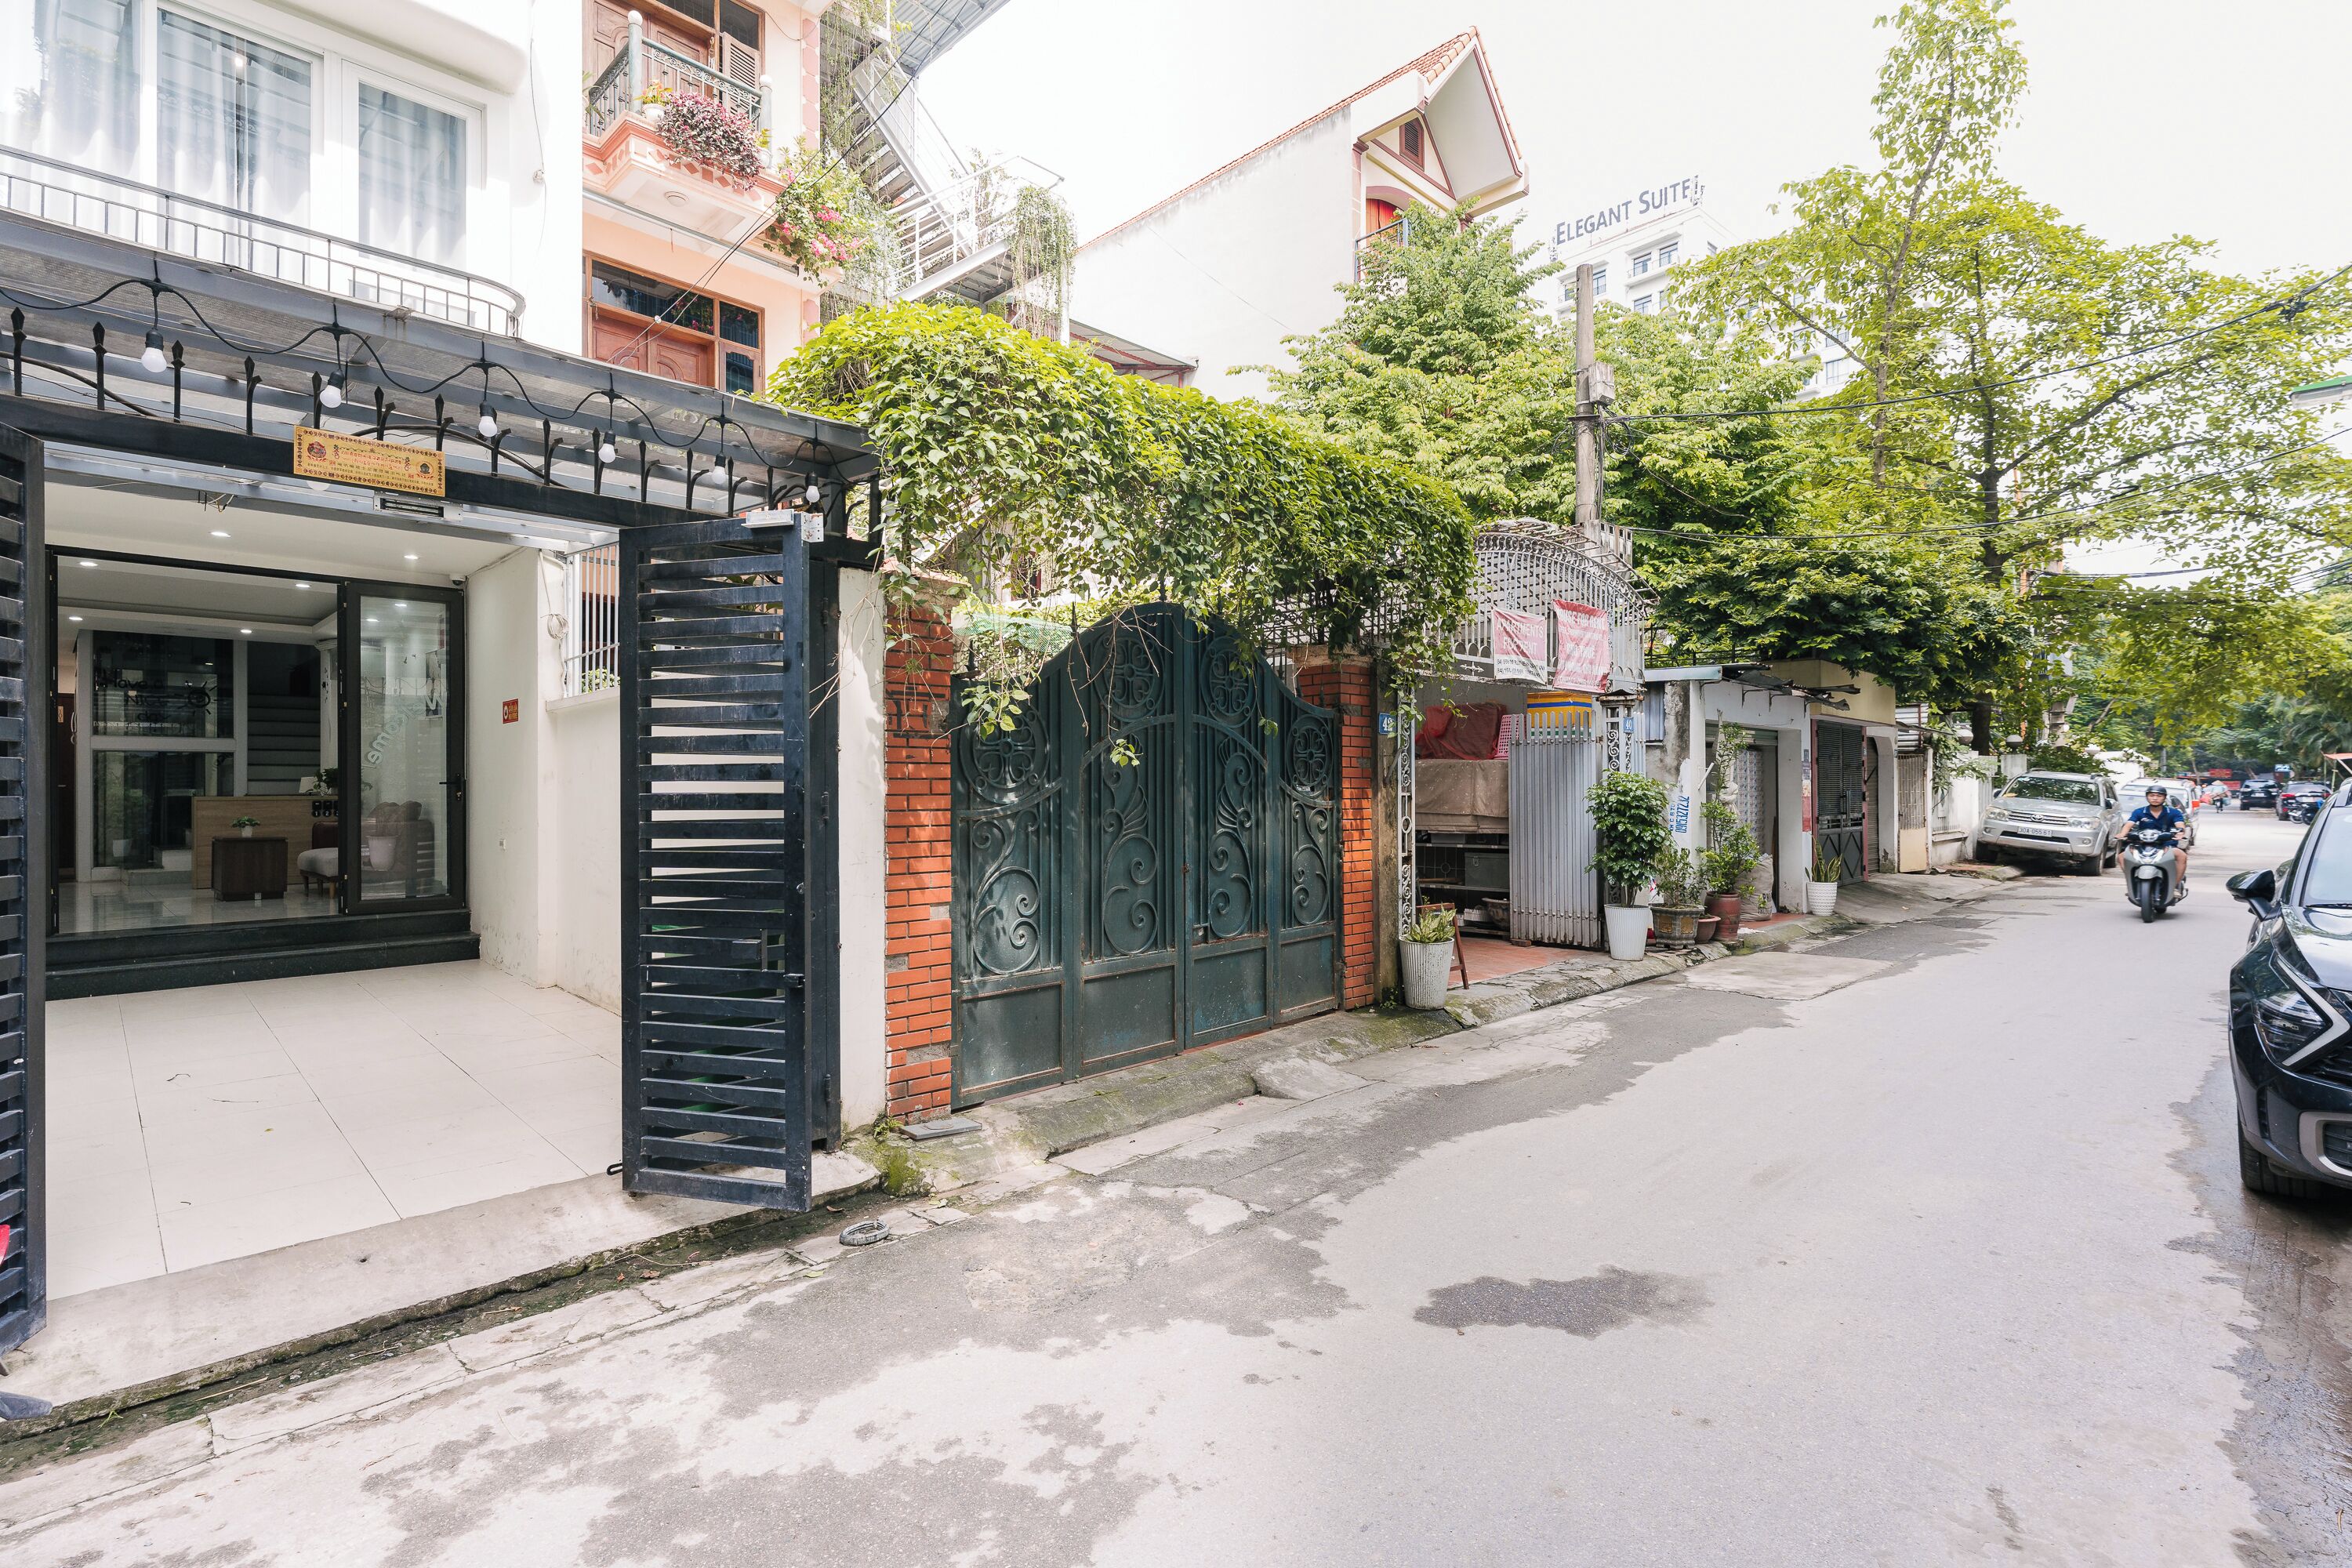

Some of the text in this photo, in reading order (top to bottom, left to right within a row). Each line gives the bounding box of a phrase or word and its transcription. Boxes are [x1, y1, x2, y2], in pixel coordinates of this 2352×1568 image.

[1556, 178, 1690, 245] ELEGANT SUITE
[1625, 719, 1632, 730] 40
